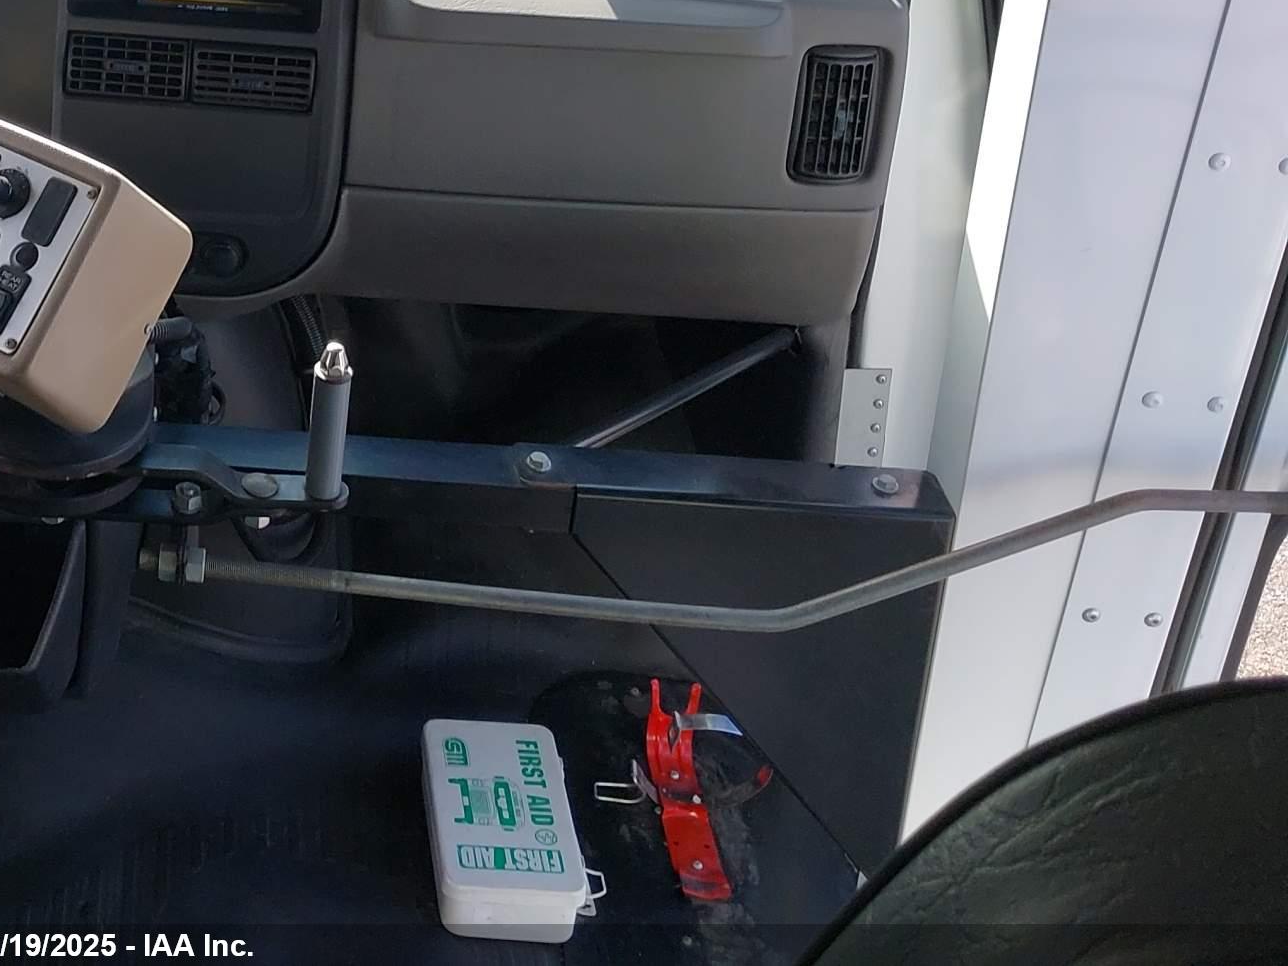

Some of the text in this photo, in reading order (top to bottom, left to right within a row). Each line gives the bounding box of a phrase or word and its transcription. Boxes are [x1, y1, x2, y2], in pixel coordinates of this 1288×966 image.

[0, 276, 18, 291] HEAT
[1, 270, 22, 284] REAR
[516, 739, 547, 789] FIRST
[526, 794, 554, 825] AID
[460, 845, 563, 873] FIRST AID
